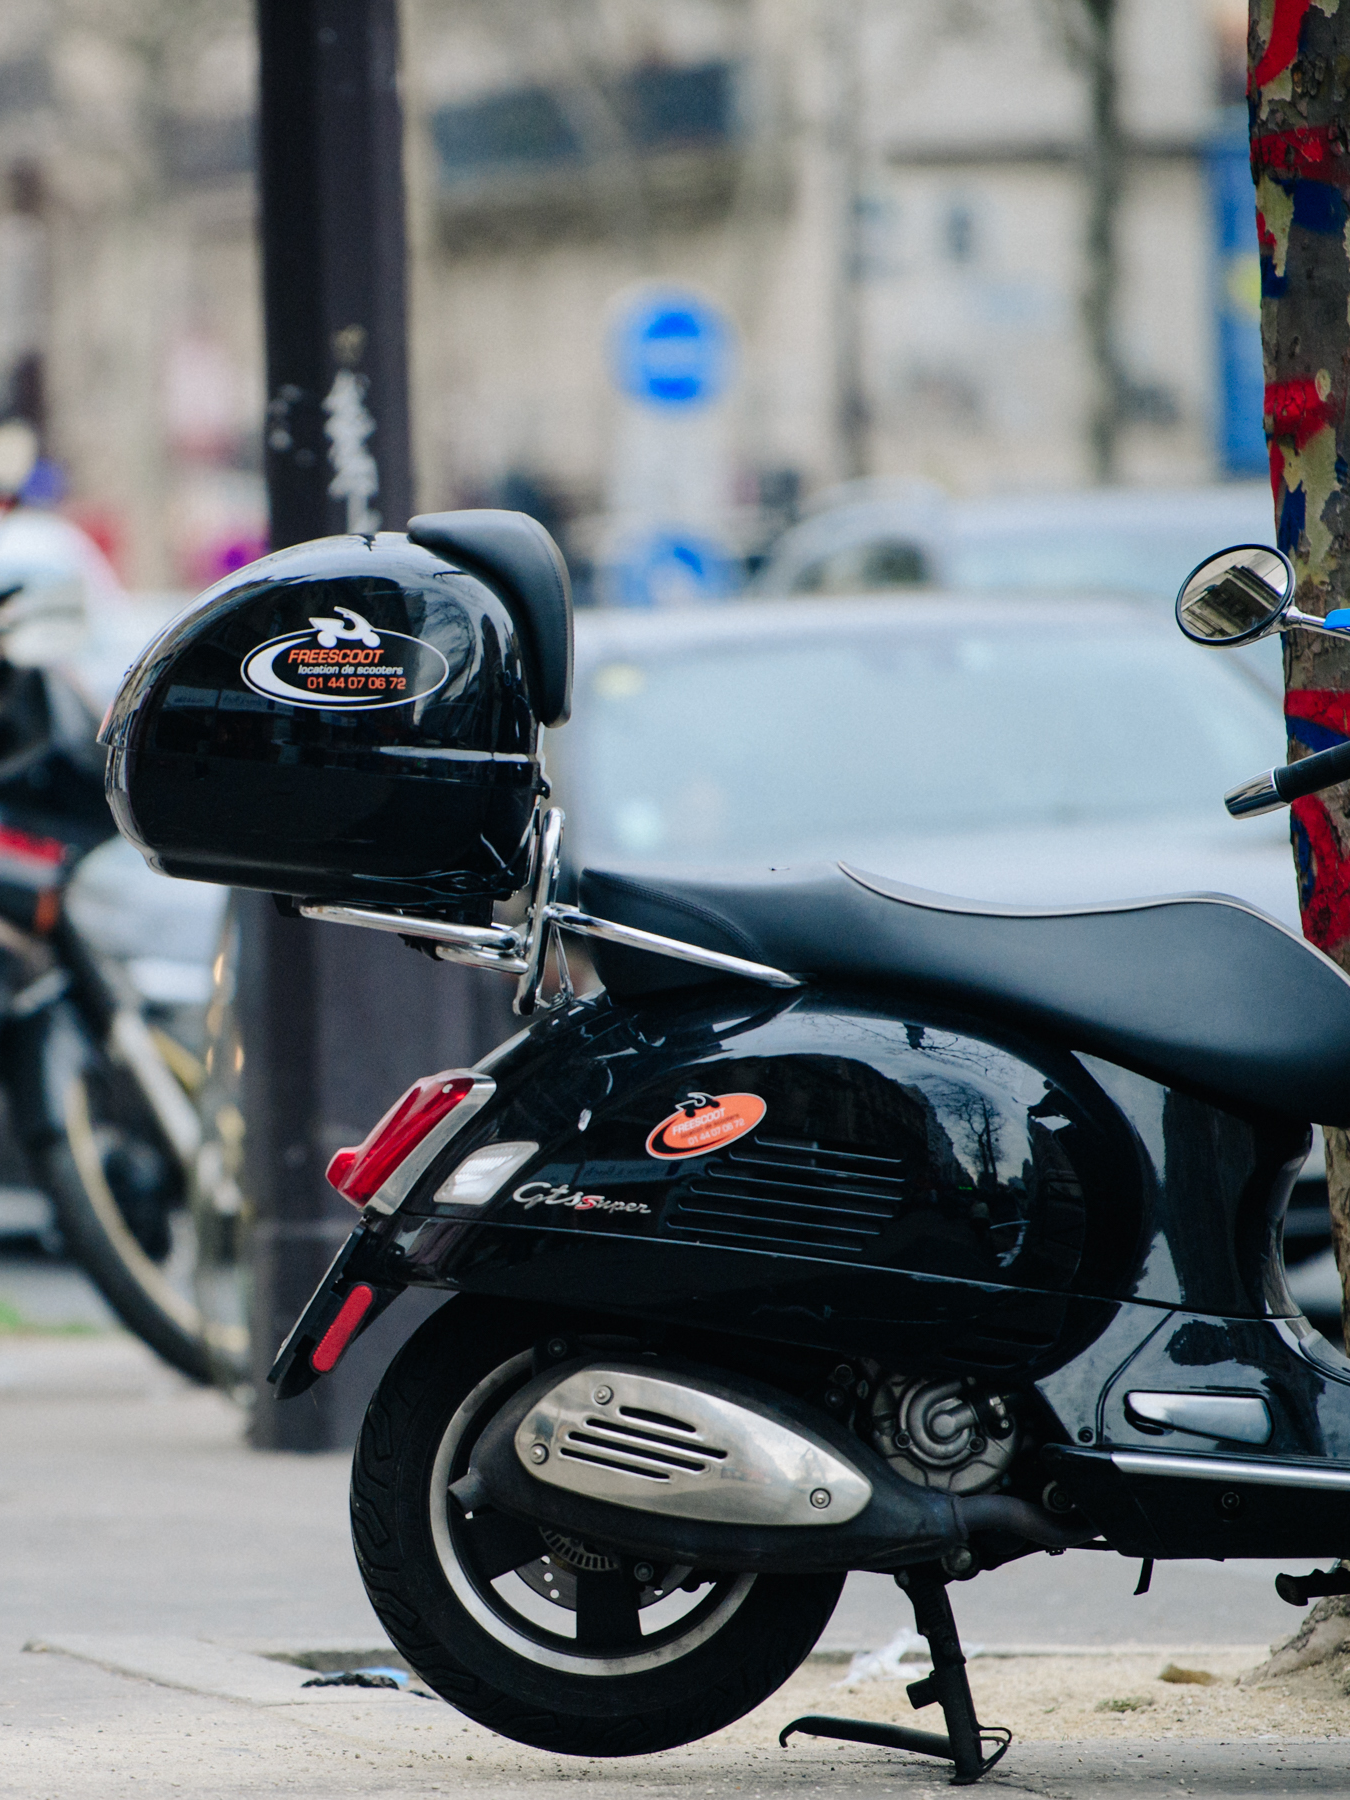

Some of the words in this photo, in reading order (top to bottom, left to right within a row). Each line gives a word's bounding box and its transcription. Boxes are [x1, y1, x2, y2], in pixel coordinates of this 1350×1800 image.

[288, 649, 384, 664] FREESCOOT
[298, 664, 340, 675] location
[341, 665, 355, 675] de
[356, 666, 404, 675] scooters
[307, 677, 324, 689] 01
[327, 677, 346, 689] 44
[347, 677, 366, 689] 07
[367, 677, 386, 689] 06
[388, 677, 406, 689] 72
[672, 1107, 726, 1136] FREESCOOT
[688, 1135, 699, 1146] 01
[699, 1131, 711, 1140] 44
[711, 1126, 721, 1137] 07
[734, 1118, 745, 1128] 72
